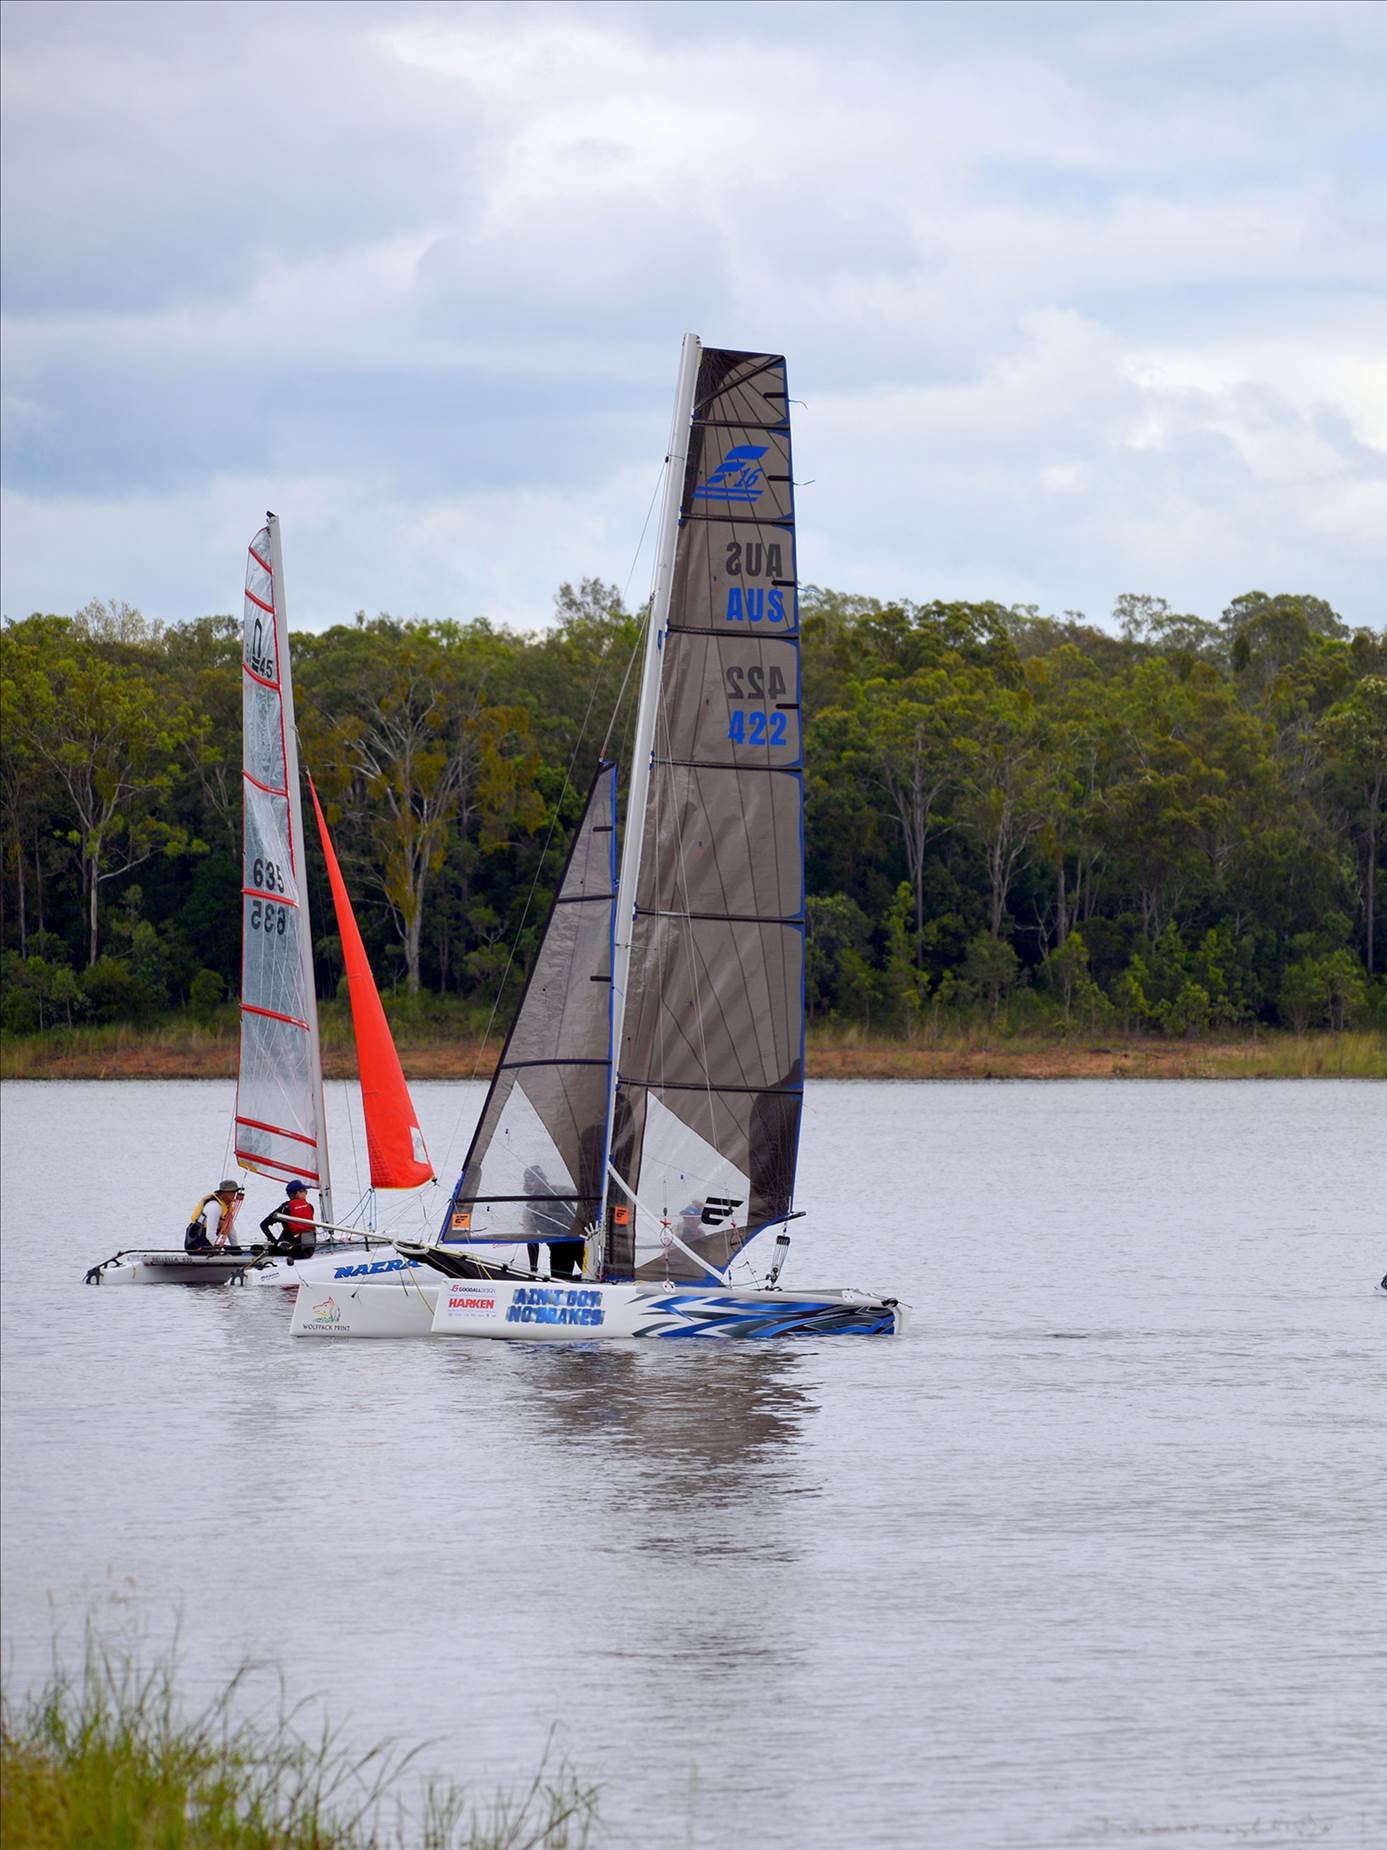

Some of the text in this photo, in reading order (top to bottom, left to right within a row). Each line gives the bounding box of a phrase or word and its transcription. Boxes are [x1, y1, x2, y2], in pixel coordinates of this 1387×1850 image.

[726, 587, 784, 622] AUS
[728, 710, 787, 745] 422
[448, 1298, 495, 1309] HARKEN
[566, 1290, 603, 1307] GOT
[534, 1306, 605, 1326] BRAKES
[303, 1323, 332, 1331] WOLFPACK
